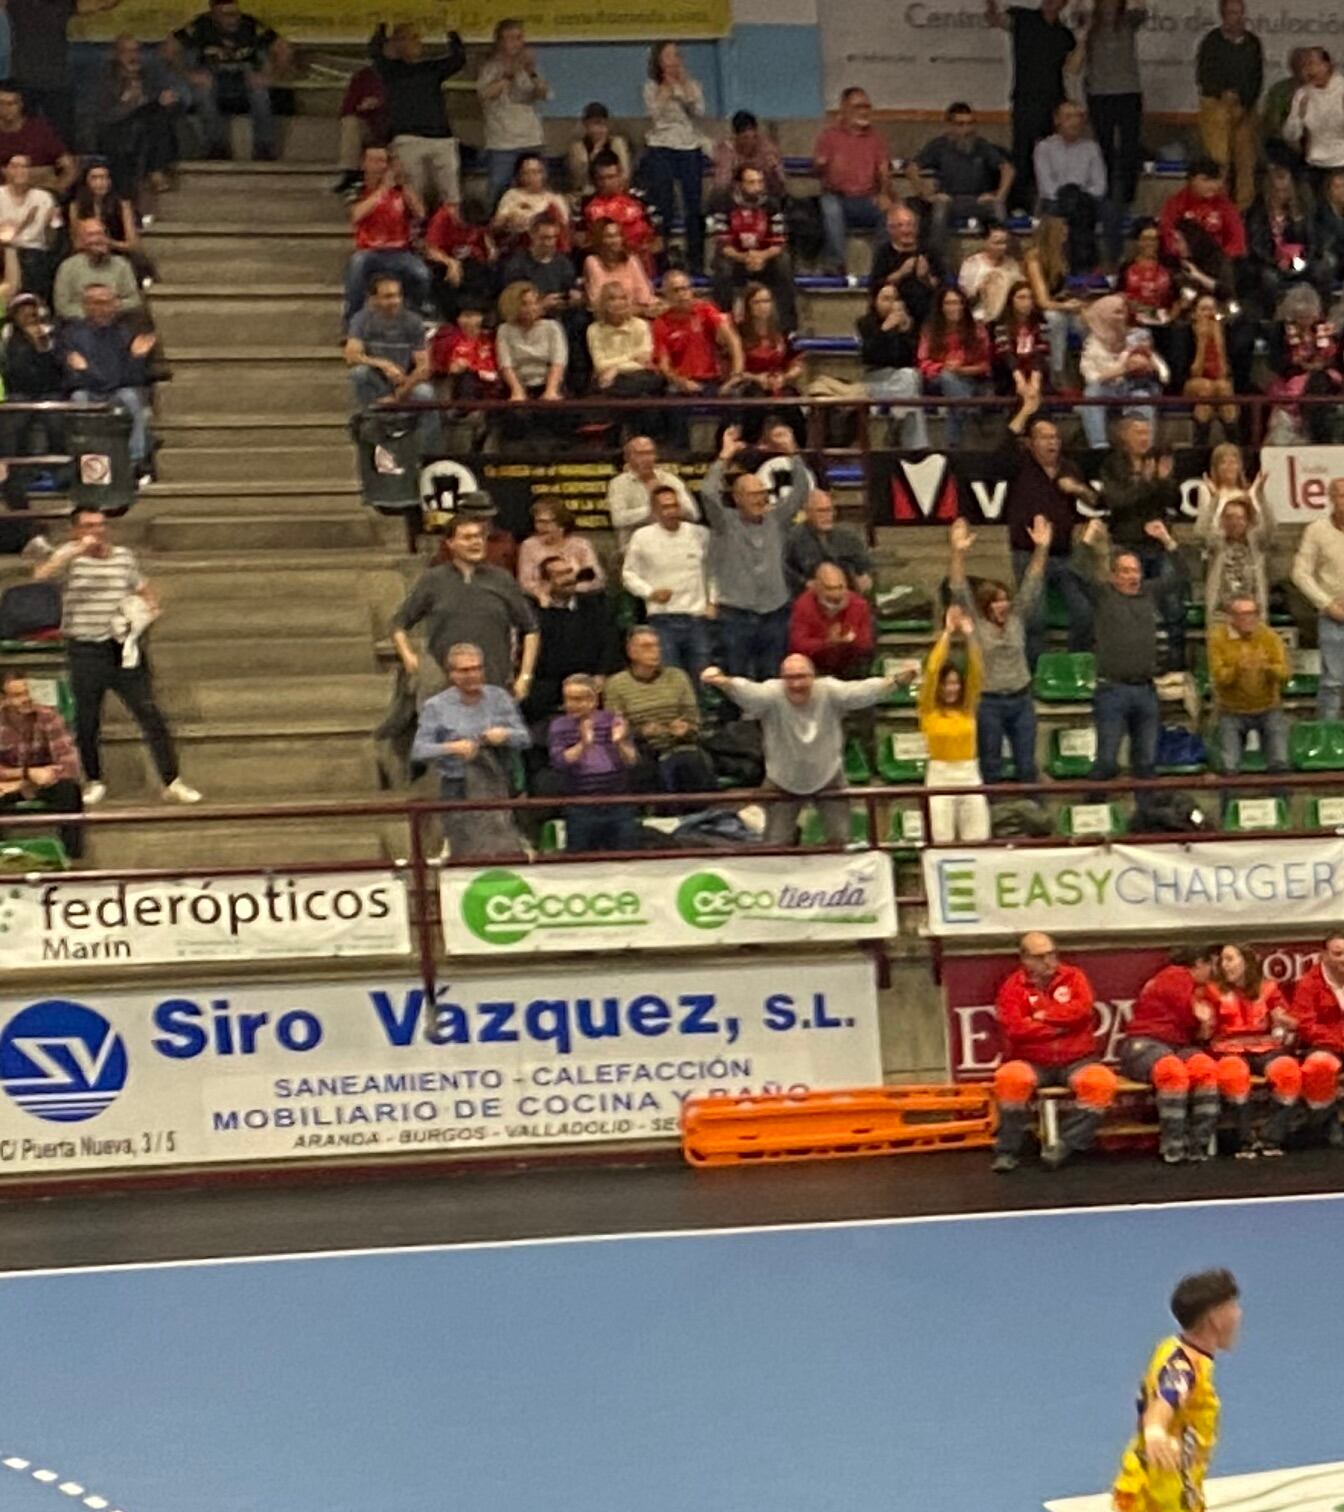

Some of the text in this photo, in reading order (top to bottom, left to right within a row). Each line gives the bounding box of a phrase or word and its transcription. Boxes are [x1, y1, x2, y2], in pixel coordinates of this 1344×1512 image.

[40, 879, 392, 936] federópticos
[151, 999, 324, 1060] Siro
[762, 992, 856, 1033] S.L.
[273, 1057, 753, 1099] SANEAMIENTO CALEFACCIÓN
[213, 1099, 438, 1132] MOBILIARIO
[454, 1098, 506, 1121] DE
[517, 1090, 661, 1117] COCINA
[292, 1131, 381, 1150] ARANDA
[398, 1126, 486, 1146] BURGOS
[504, 1118, 632, 1138] VALLADOLID
